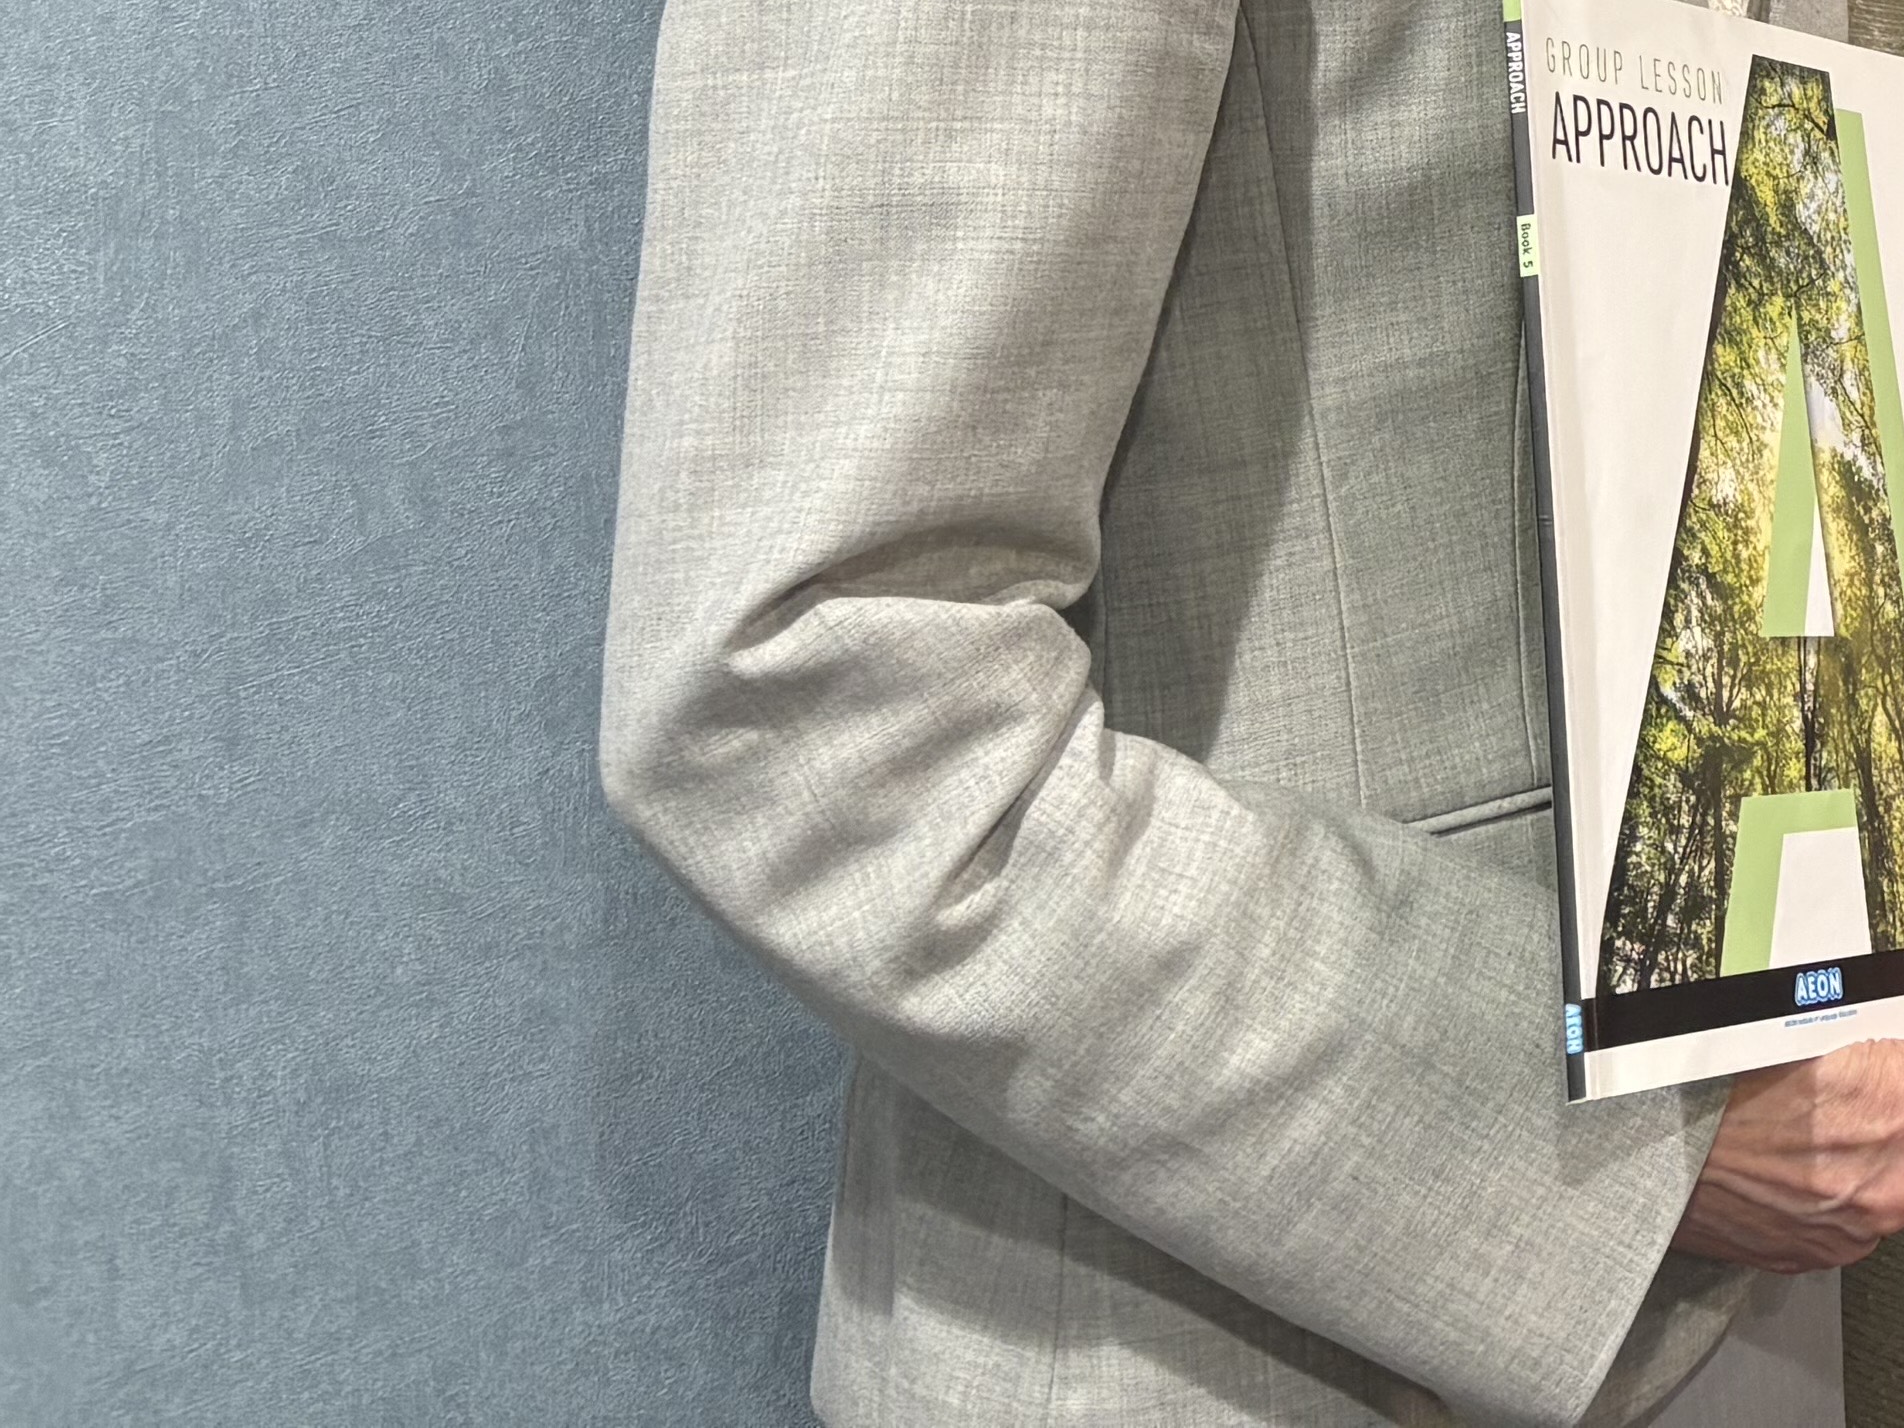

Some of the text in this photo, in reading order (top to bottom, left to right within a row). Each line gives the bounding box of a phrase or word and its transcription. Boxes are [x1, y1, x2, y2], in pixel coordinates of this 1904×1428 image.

[1505, 31, 1527, 114] APPROACH
[1545, 36, 1724, 106] GROUP LESSON
[1551, 90, 1730, 187] APPROACH
[1519, 222, 1534, 270] Book 5
[1795, 967, 1843, 1006] AEON
[1565, 1004, 1584, 1055] AEON
